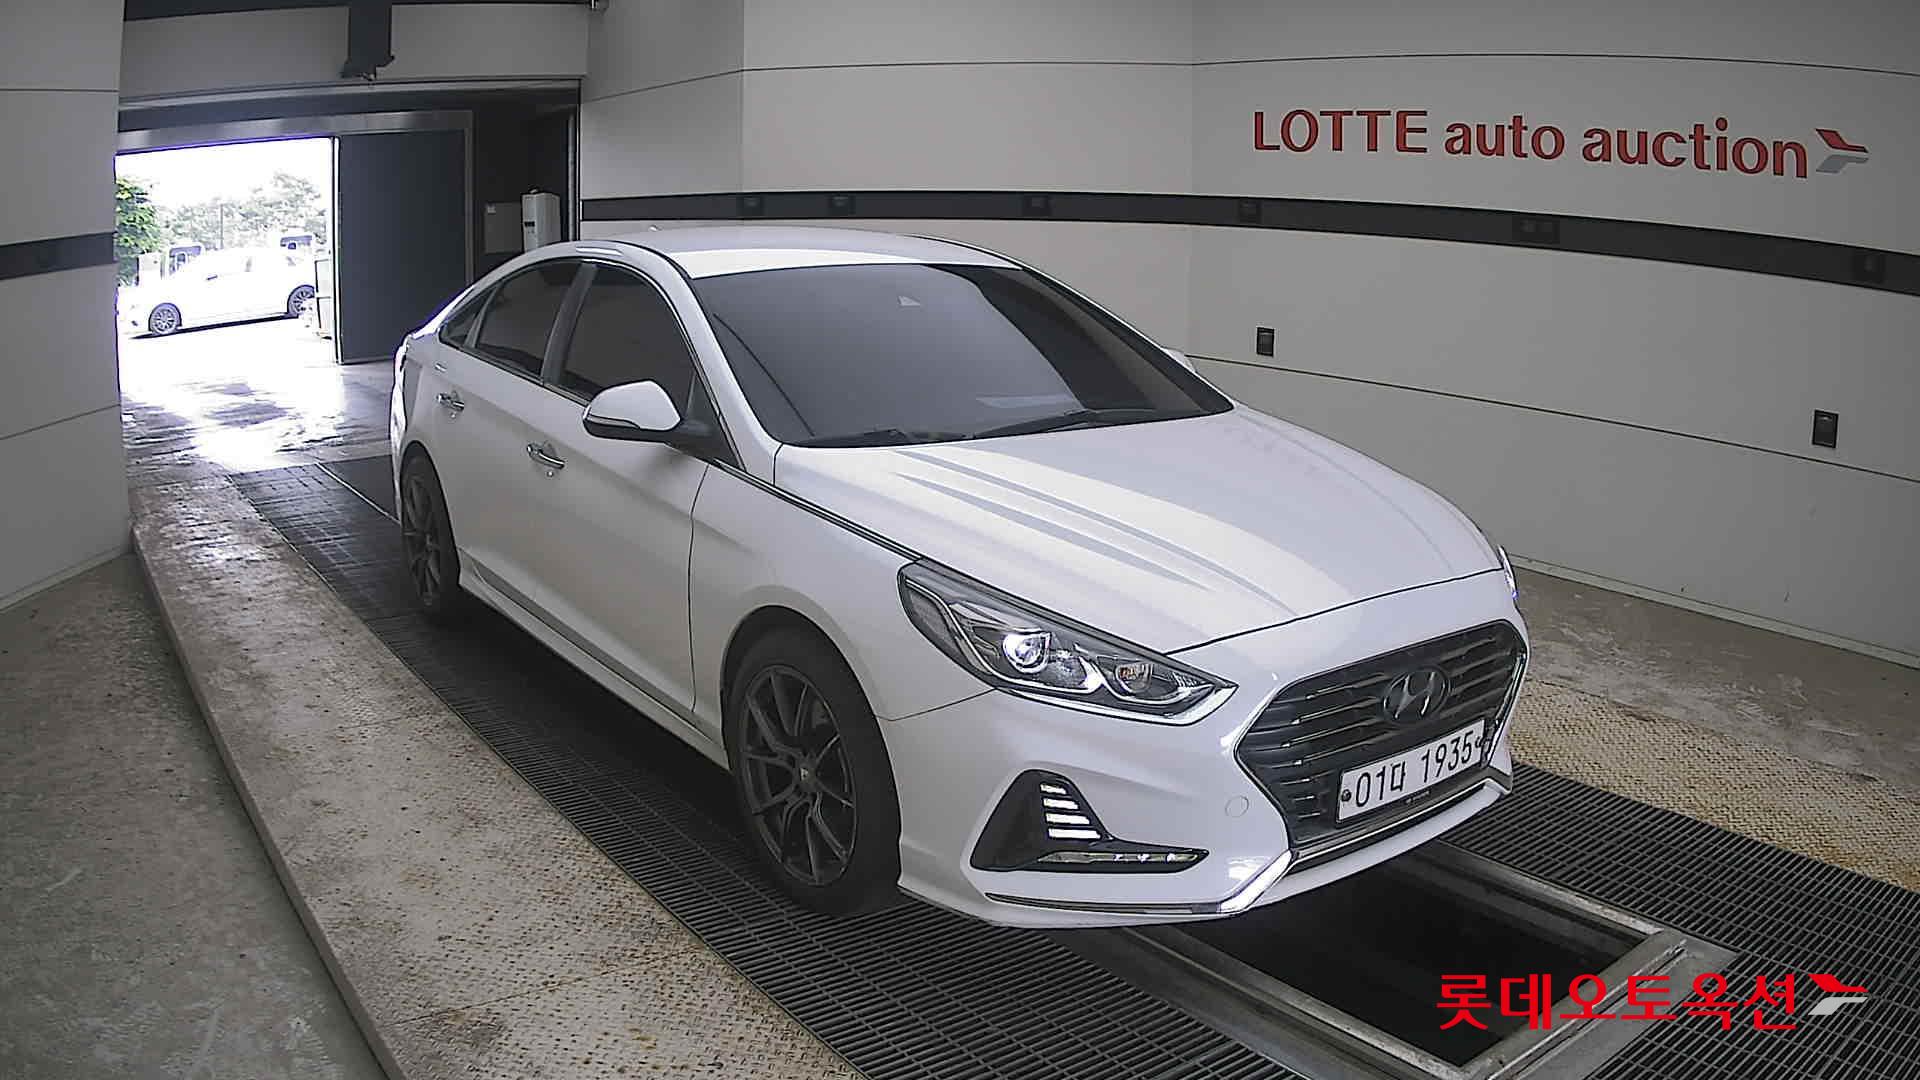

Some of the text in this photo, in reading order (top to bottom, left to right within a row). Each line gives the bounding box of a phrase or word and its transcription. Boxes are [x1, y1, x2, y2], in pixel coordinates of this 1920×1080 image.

[1253, 110, 1809, 178] LOTTE auto auction
[1421, 730, 1474, 783] 1935
